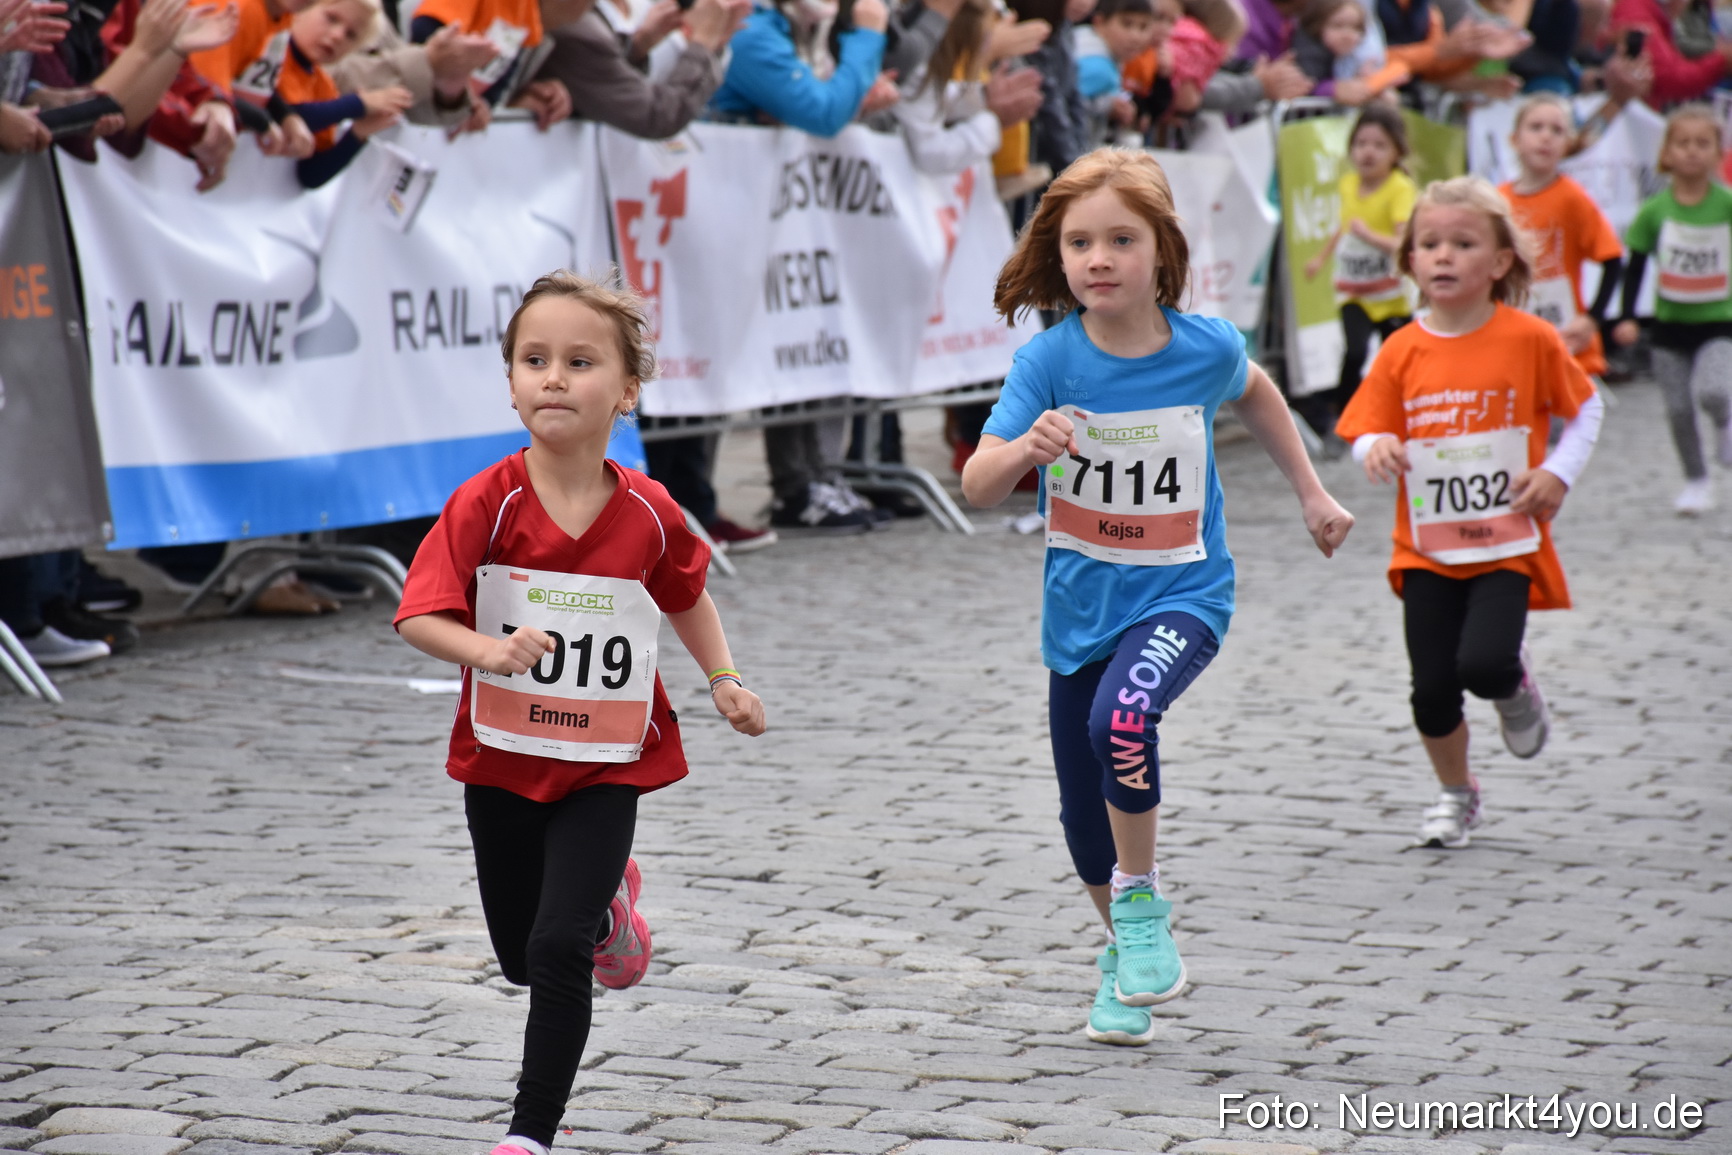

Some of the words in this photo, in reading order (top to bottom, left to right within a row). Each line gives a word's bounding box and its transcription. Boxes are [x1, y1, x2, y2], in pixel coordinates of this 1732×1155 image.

[390, 283, 526, 353] RAIL.O
[1102, 425, 1159, 441] BOCK
[1052, 482, 1062, 493] B1
[1069, 454, 1181, 505] 7114
[1426, 470, 1511, 514] 7032
[1098, 519, 1144, 541] Kajsa
[548, 590, 614, 610] BOCK
[529, 704, 590, 729] Emma
[1110, 624, 1188, 790] AWESOME
